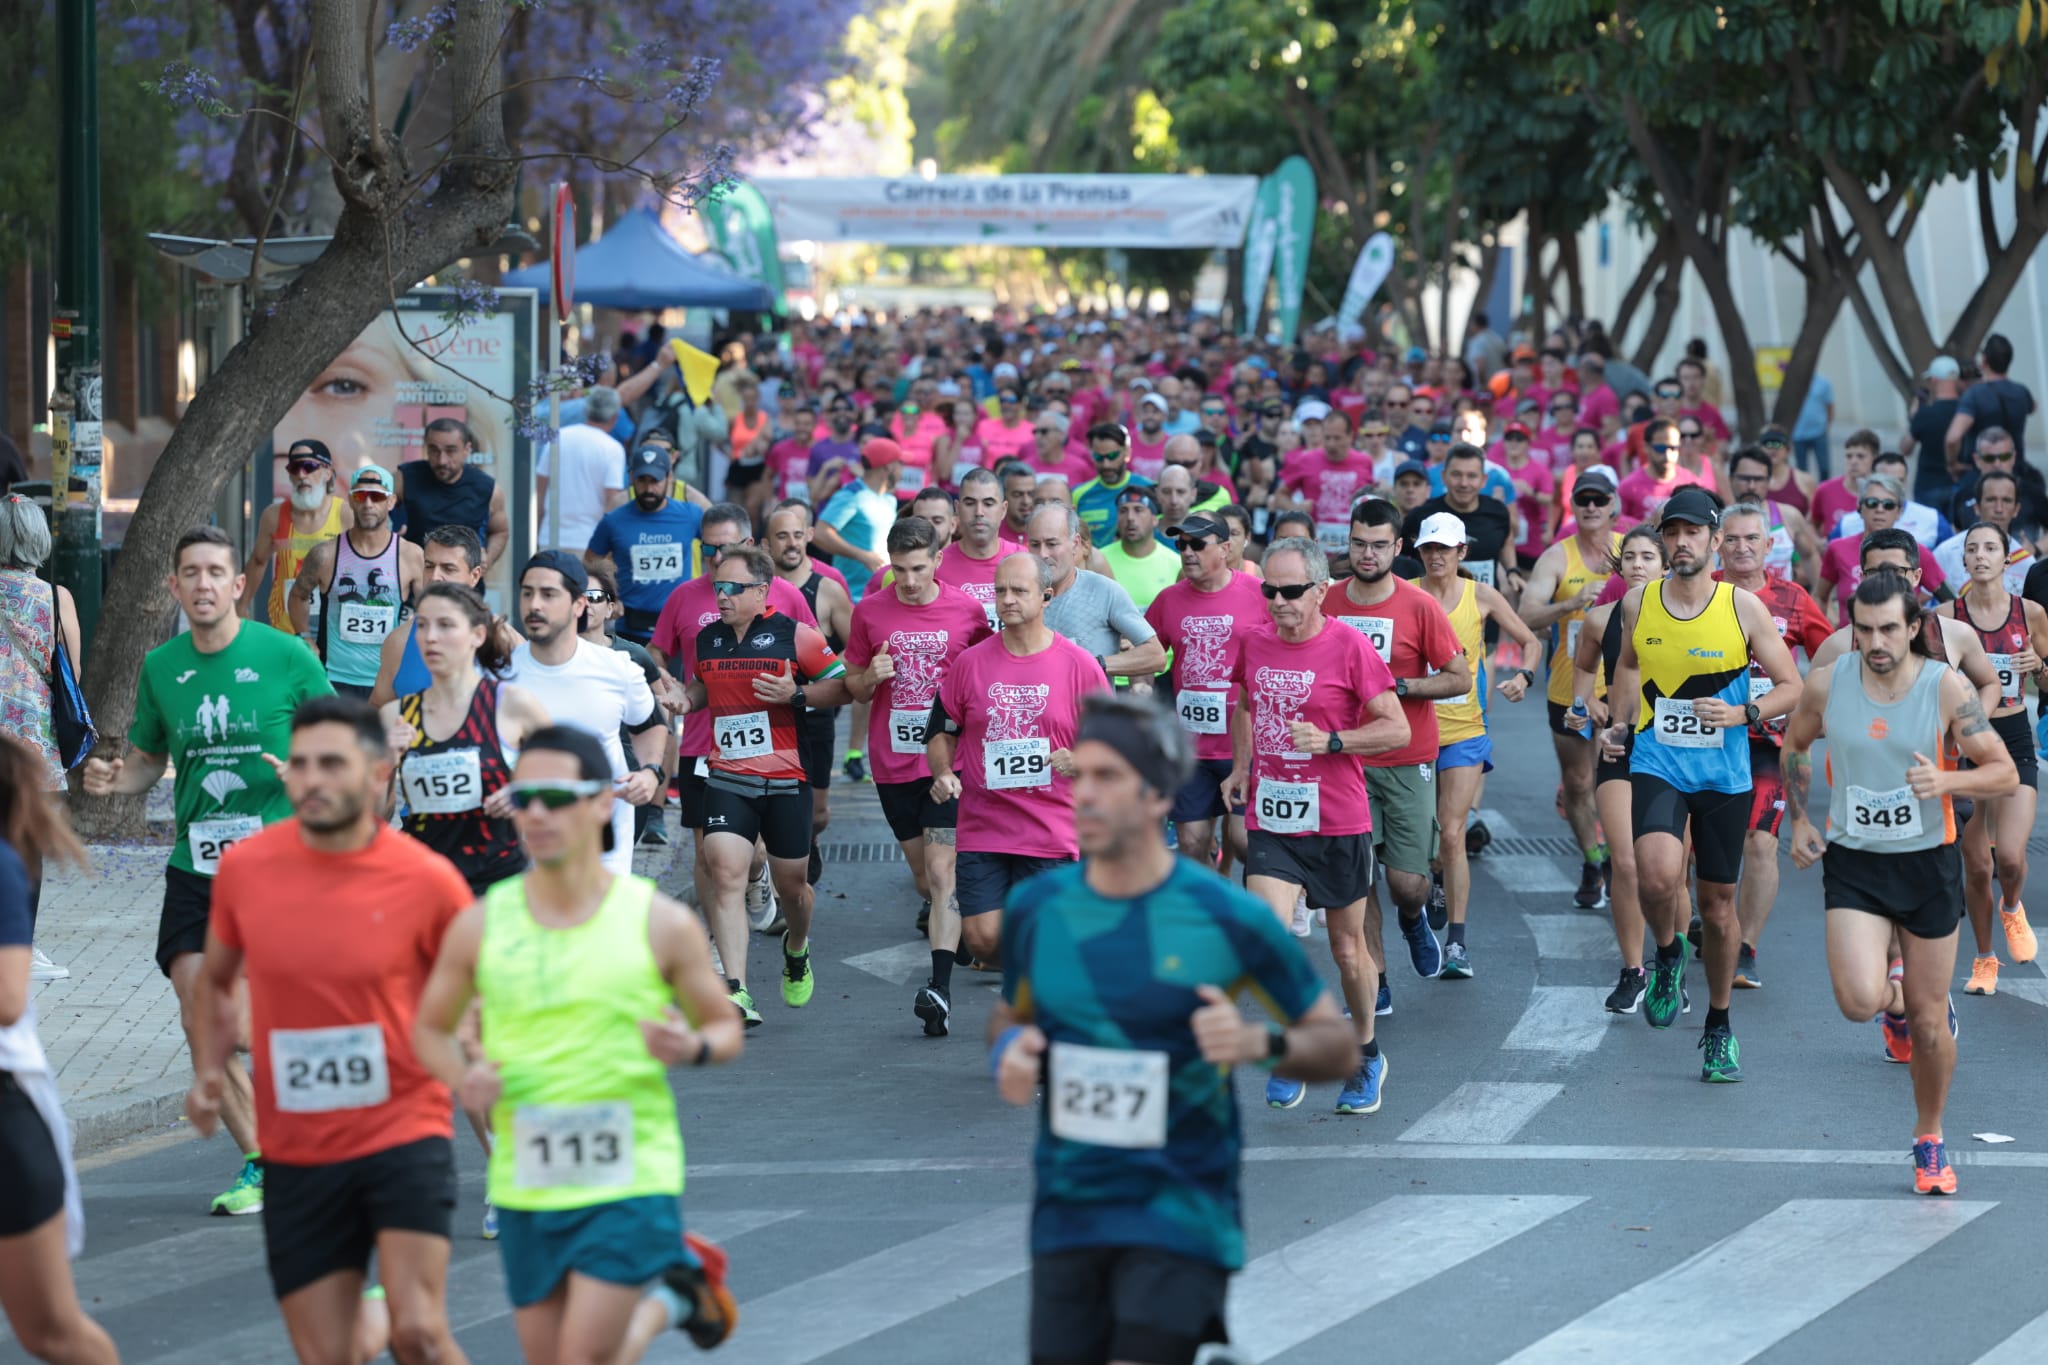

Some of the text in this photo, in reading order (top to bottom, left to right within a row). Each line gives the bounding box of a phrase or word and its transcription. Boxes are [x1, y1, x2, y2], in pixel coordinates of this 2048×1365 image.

[884, 181, 1132, 203] Carrera de la Prensa
[639, 556, 677, 571] 574
[346, 617, 387, 634] 231
[718, 659, 778, 671] ARCHIDONA
[1181, 705, 1220, 722] 498
[720, 728, 765, 749] 413
[993, 754, 1044, 776] 129
[413, 773, 472, 797] 152
[1262, 798, 1310, 819] 607
[1855, 804, 1912, 827] 348
[287, 1056, 371, 1089] 249
[1064, 1080, 1147, 1119] 227
[527, 1132, 620, 1164] 113
